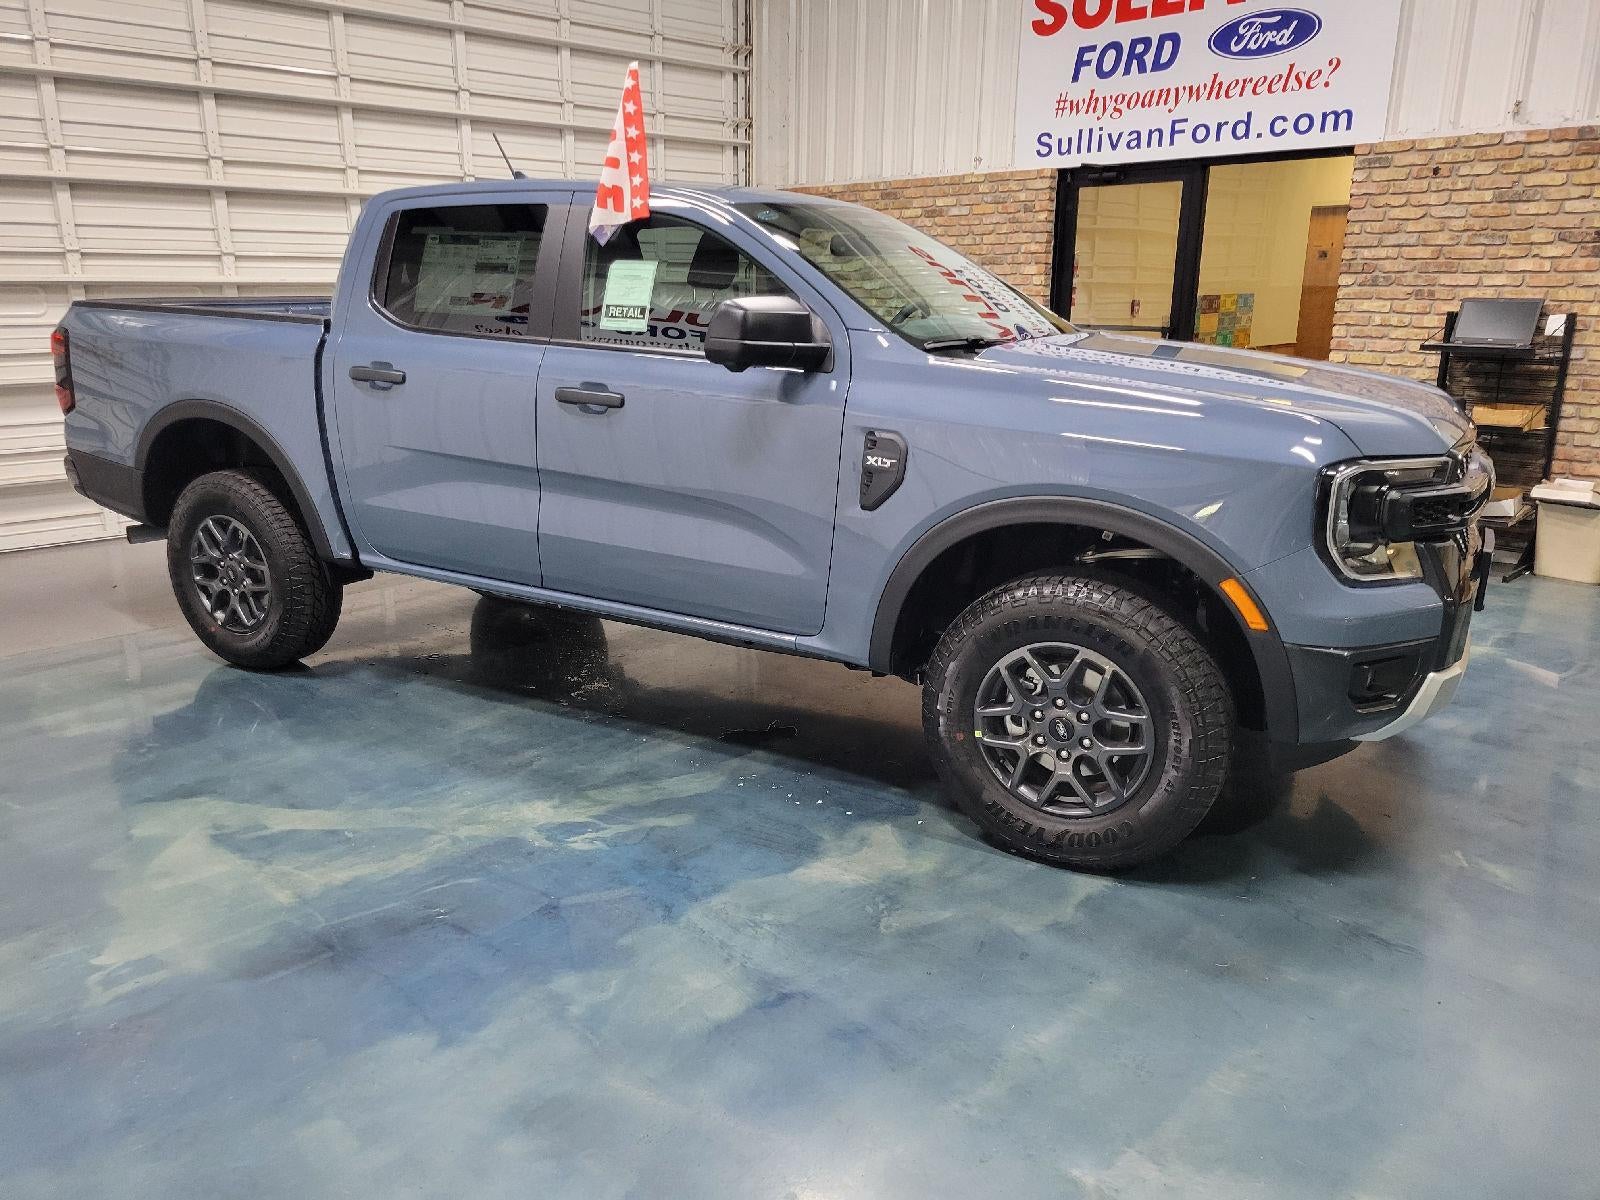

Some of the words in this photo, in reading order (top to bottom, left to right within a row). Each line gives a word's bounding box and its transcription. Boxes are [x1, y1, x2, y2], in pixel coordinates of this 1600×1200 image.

[1230, 16, 1297, 53] Ford
[1071, 32, 1182, 83] FORD
[1055, 56, 1342, 121] #whygoanywhereelse?
[1036, 108, 1354, 158] SullivanFord.com
[608, 305, 644, 319] RETAIL
[866, 455, 898, 468] XLT
